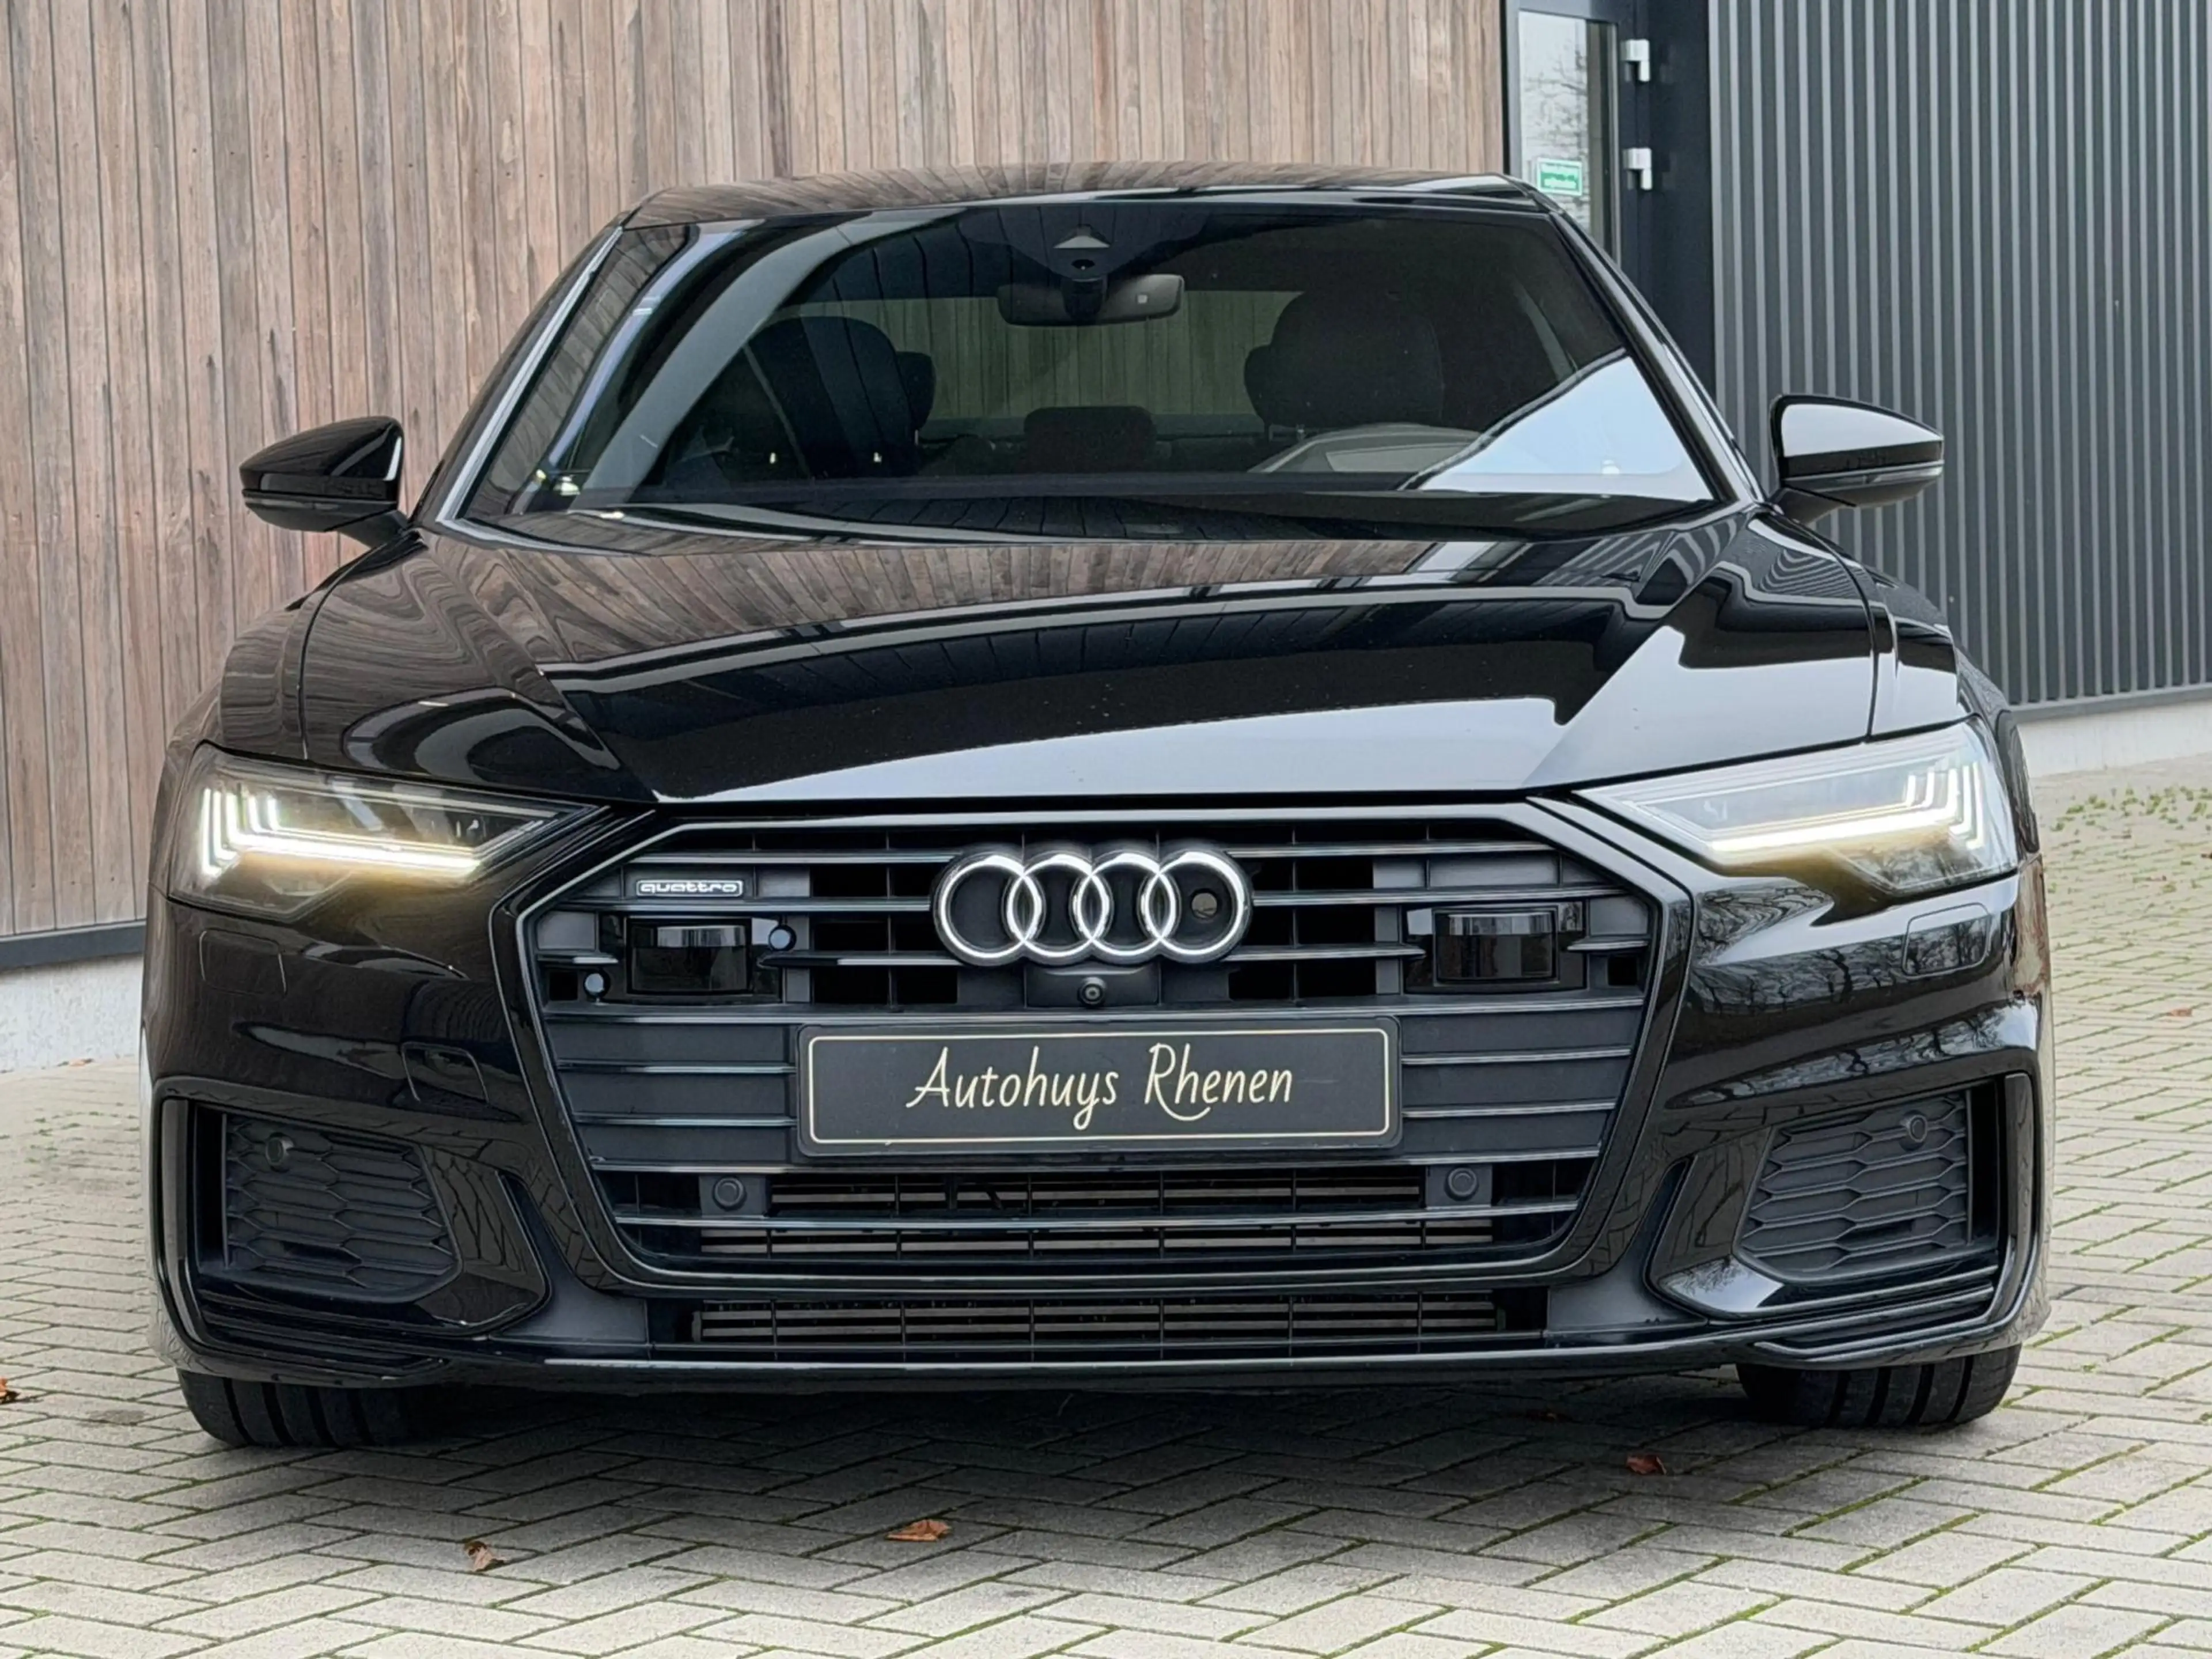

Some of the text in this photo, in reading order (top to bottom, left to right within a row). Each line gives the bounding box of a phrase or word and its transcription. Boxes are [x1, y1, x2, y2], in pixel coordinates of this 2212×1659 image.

[640, 882, 738, 894] quattro
[905, 1042, 1293, 1131] Autohuys Rhenen
